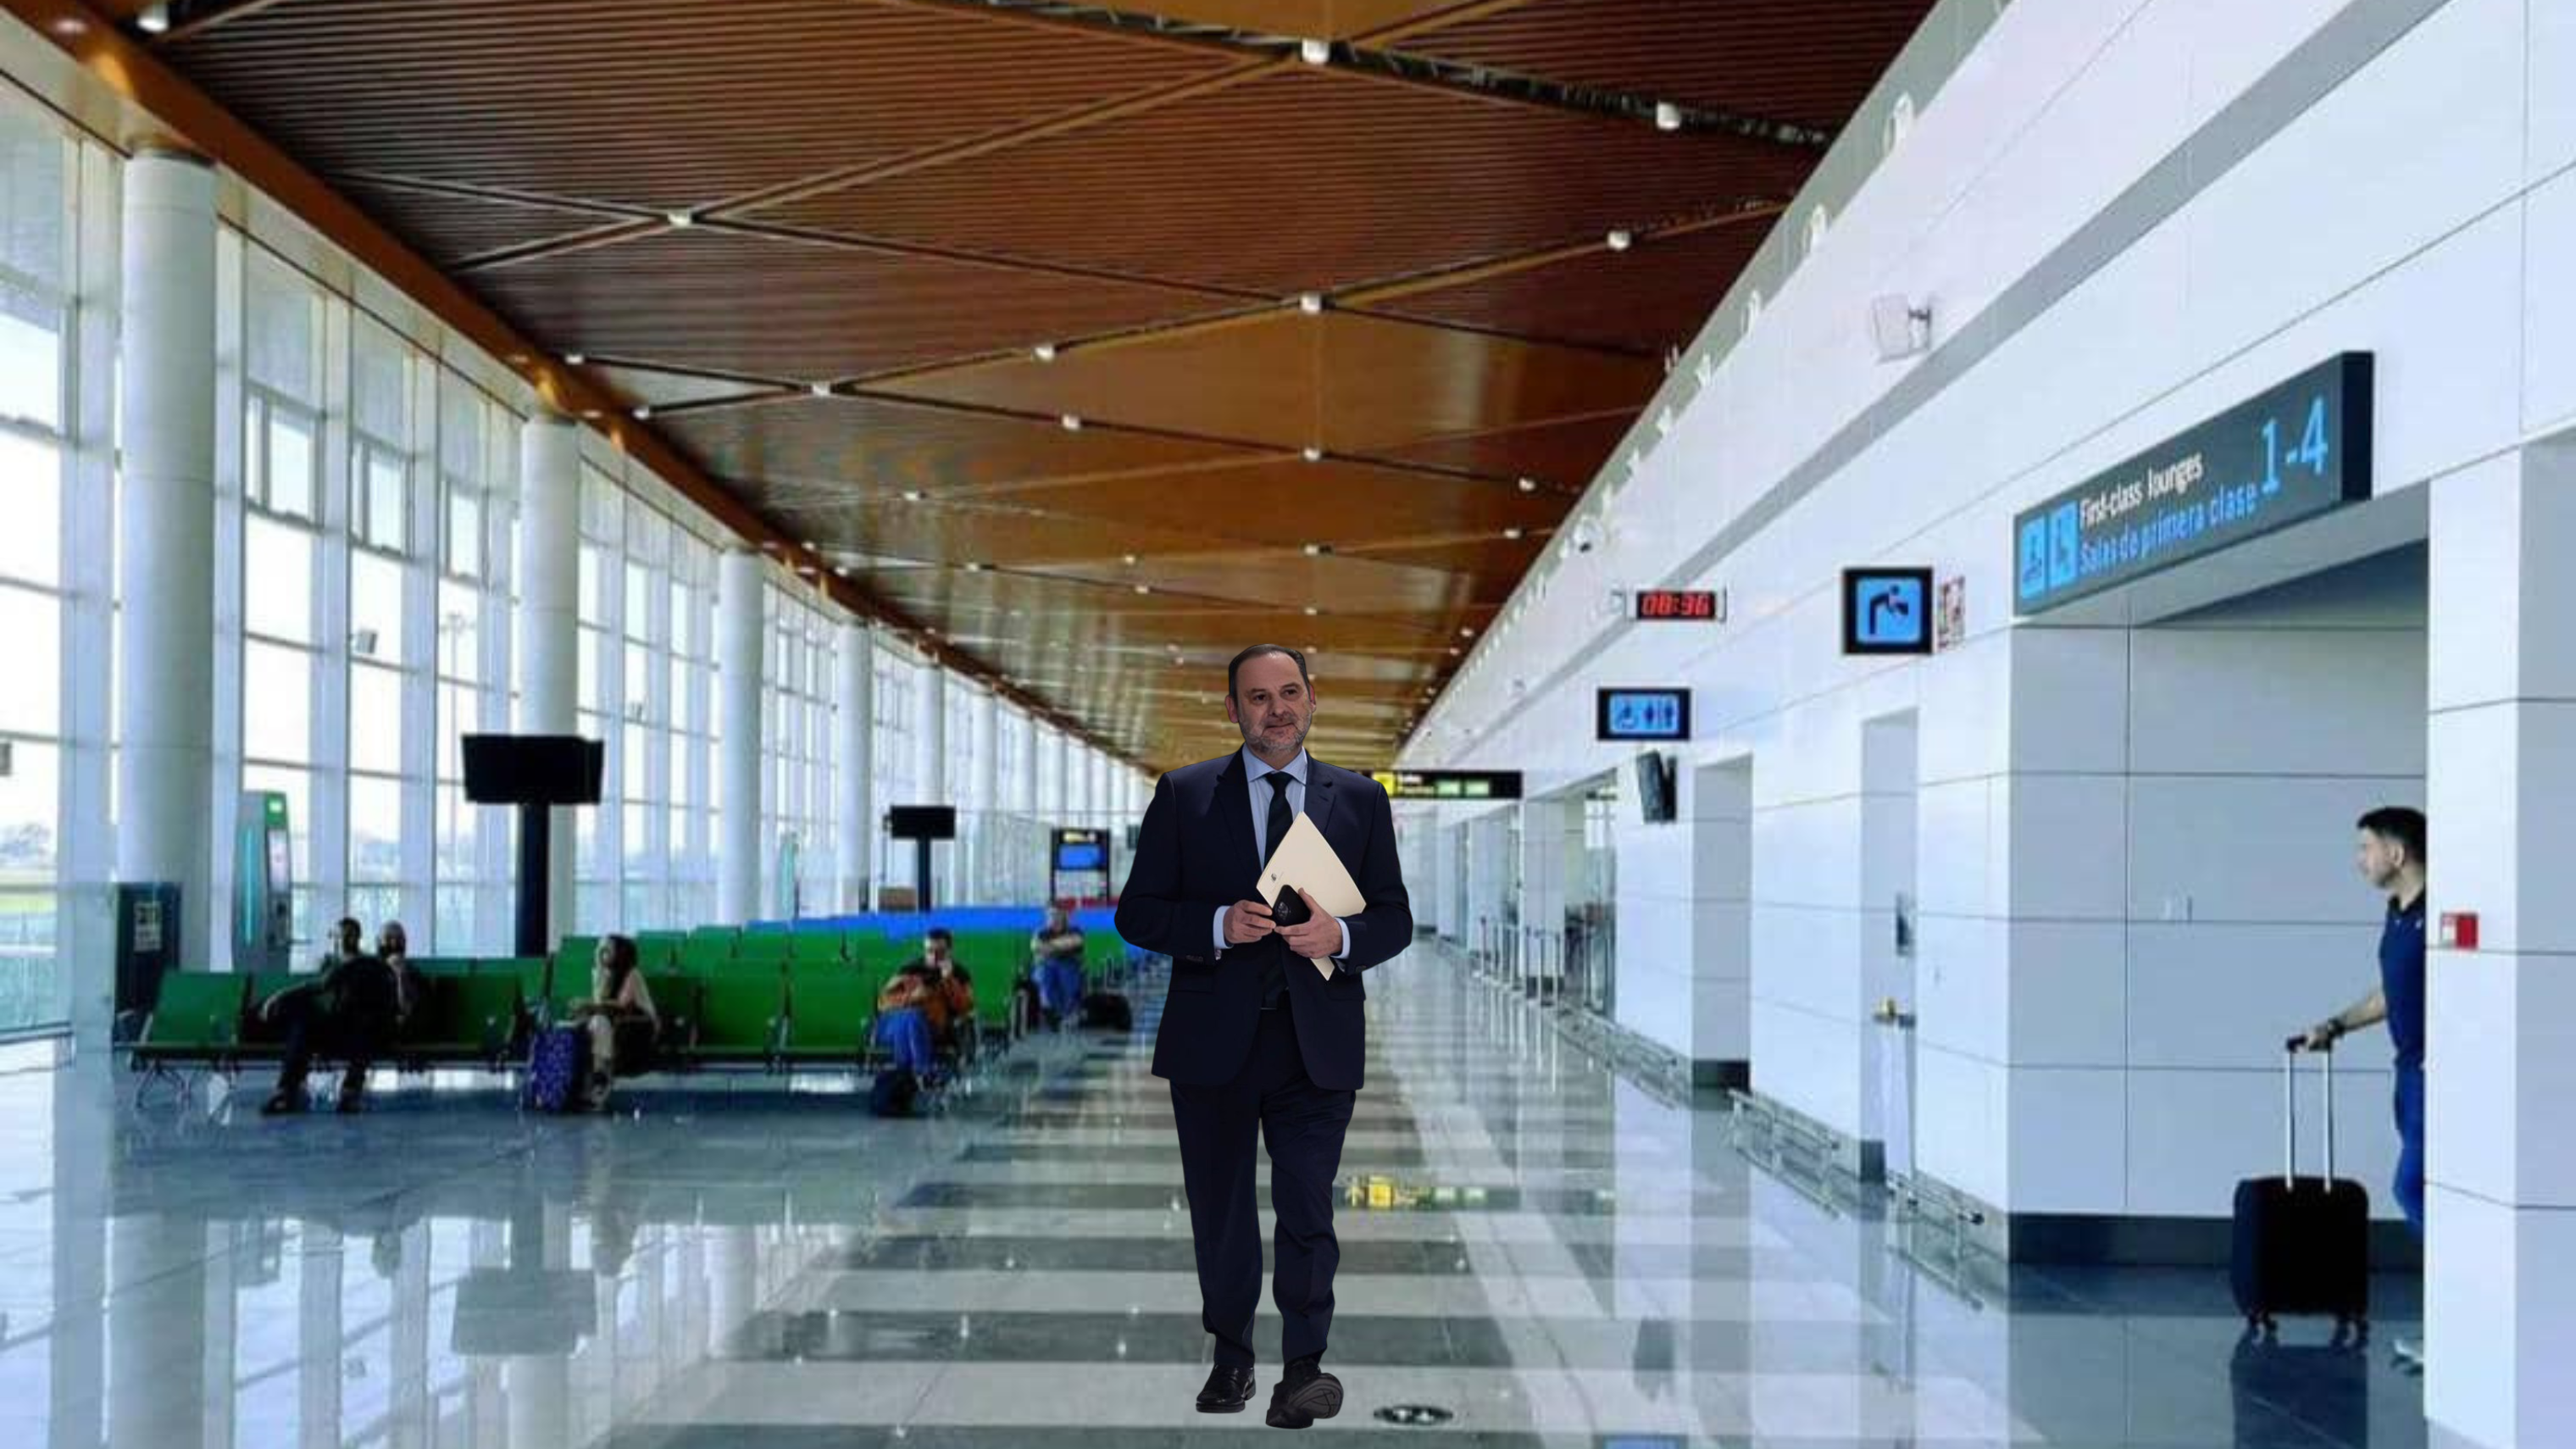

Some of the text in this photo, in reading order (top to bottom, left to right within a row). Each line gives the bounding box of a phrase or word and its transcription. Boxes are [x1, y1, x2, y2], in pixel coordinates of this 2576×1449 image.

[2261, 396, 2329, 493] 1-4
[2079, 451, 2203, 530] First-class lounges
[2119, 522, 2138, 562] de
[2140, 502, 2205, 558] primera
[2211, 483, 2256, 526] clase
[1642, 594, 1709, 615] 08:36
